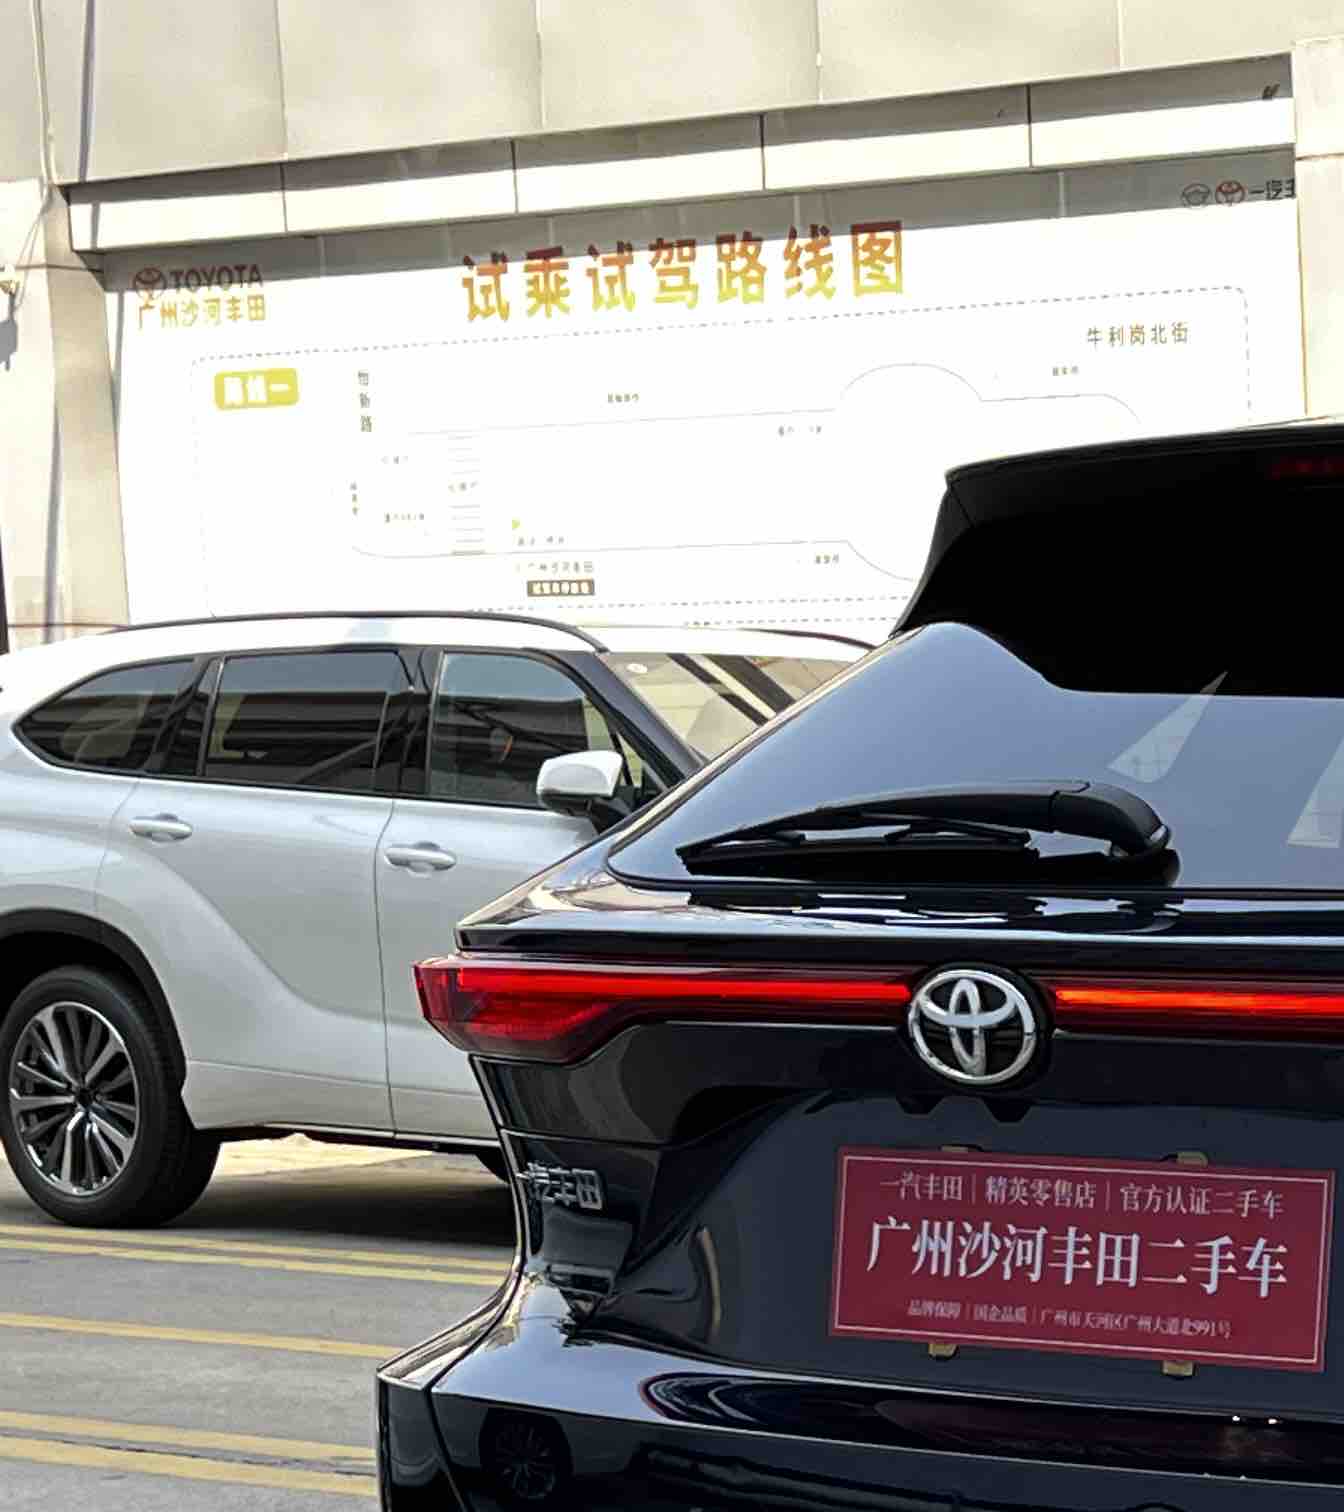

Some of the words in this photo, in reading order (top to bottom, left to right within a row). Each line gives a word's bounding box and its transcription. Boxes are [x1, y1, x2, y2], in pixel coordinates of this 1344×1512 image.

[170, 264, 264, 293] TOYOTA
[461, 219, 904, 323] 试乘试驾路线图
[880, 1170, 963, 1202] 一汽丰田
[984, 1176, 1097, 1209] 精英零售店
[1119, 1182, 1284, 1219] 官方认证二手车
[866, 1215, 1288, 1298] 广州沙河丰田二手车
